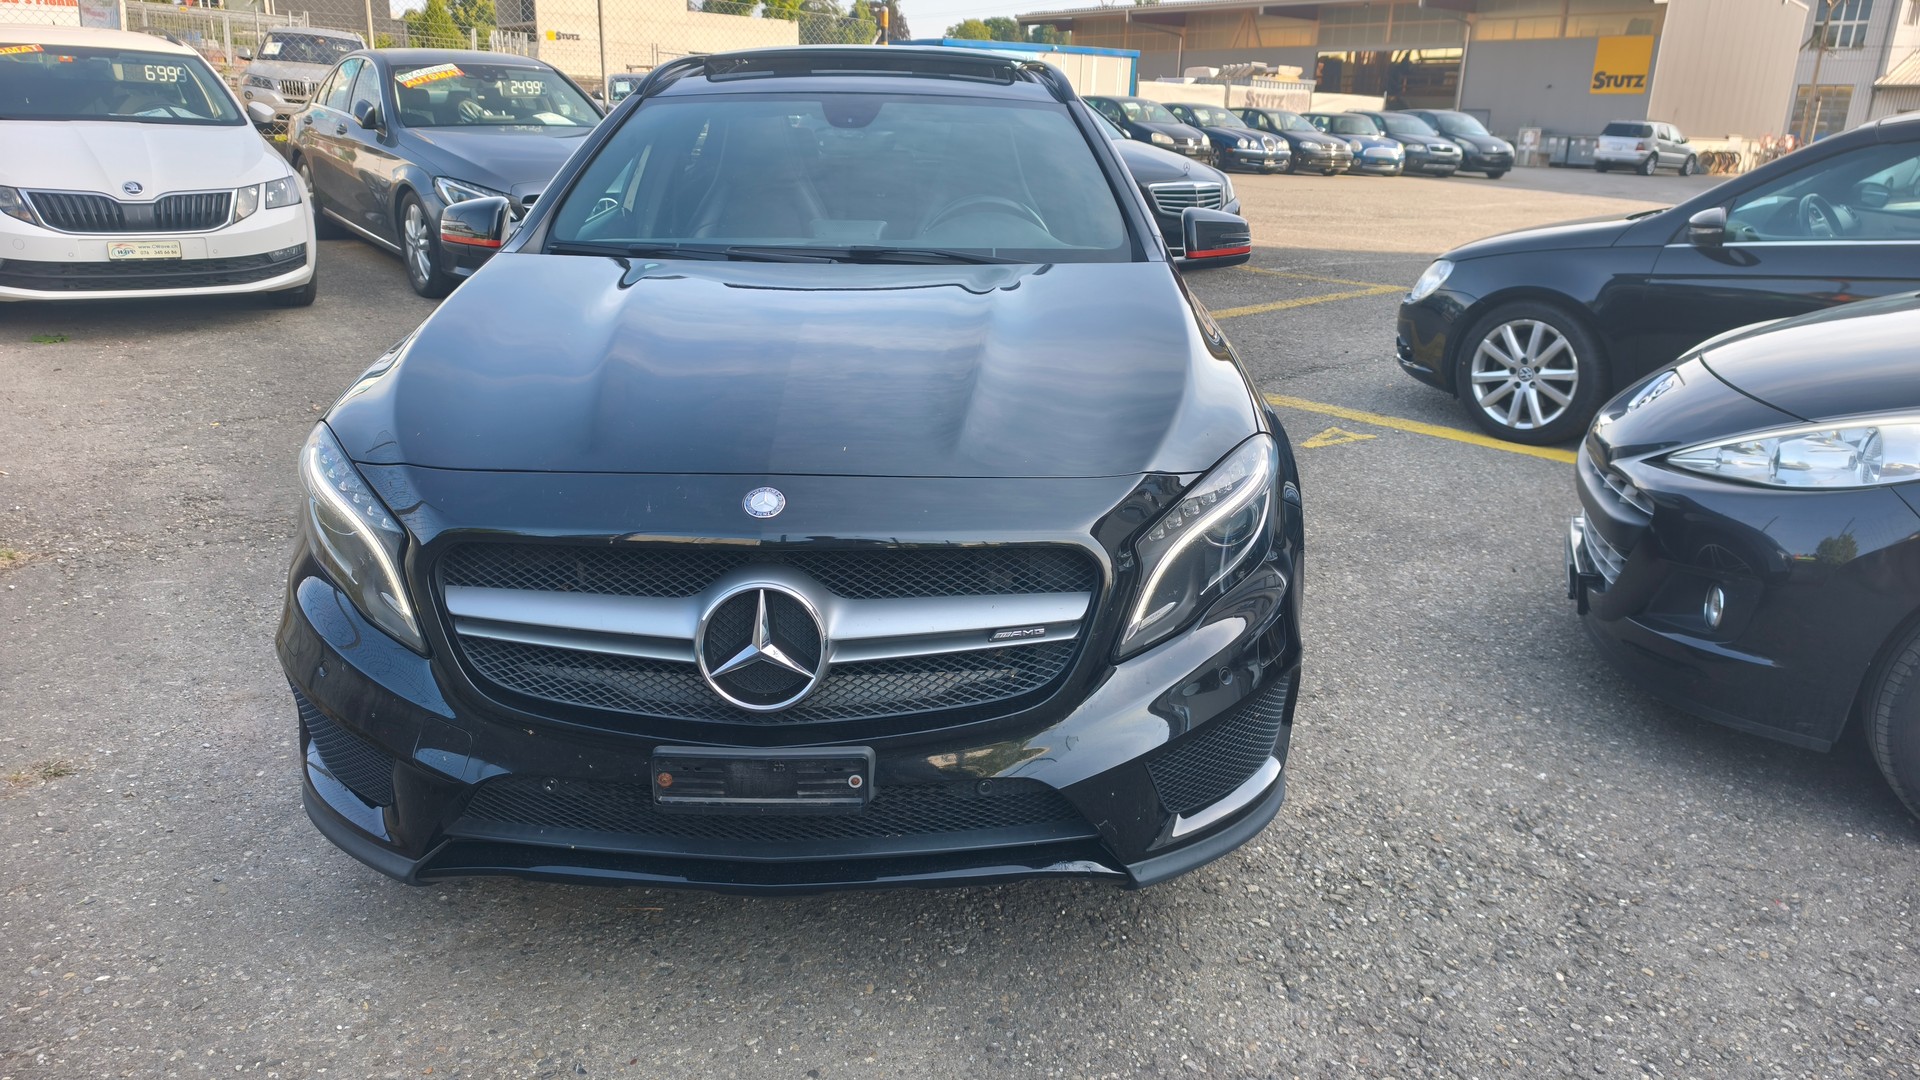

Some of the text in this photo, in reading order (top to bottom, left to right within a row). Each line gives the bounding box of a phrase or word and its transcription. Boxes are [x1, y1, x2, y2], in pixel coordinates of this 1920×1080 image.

[404, 69, 462, 88] AUTOMAT
[1592, 71, 1646, 89] STUTZ
[1010, 628, 1045, 637] AMG
